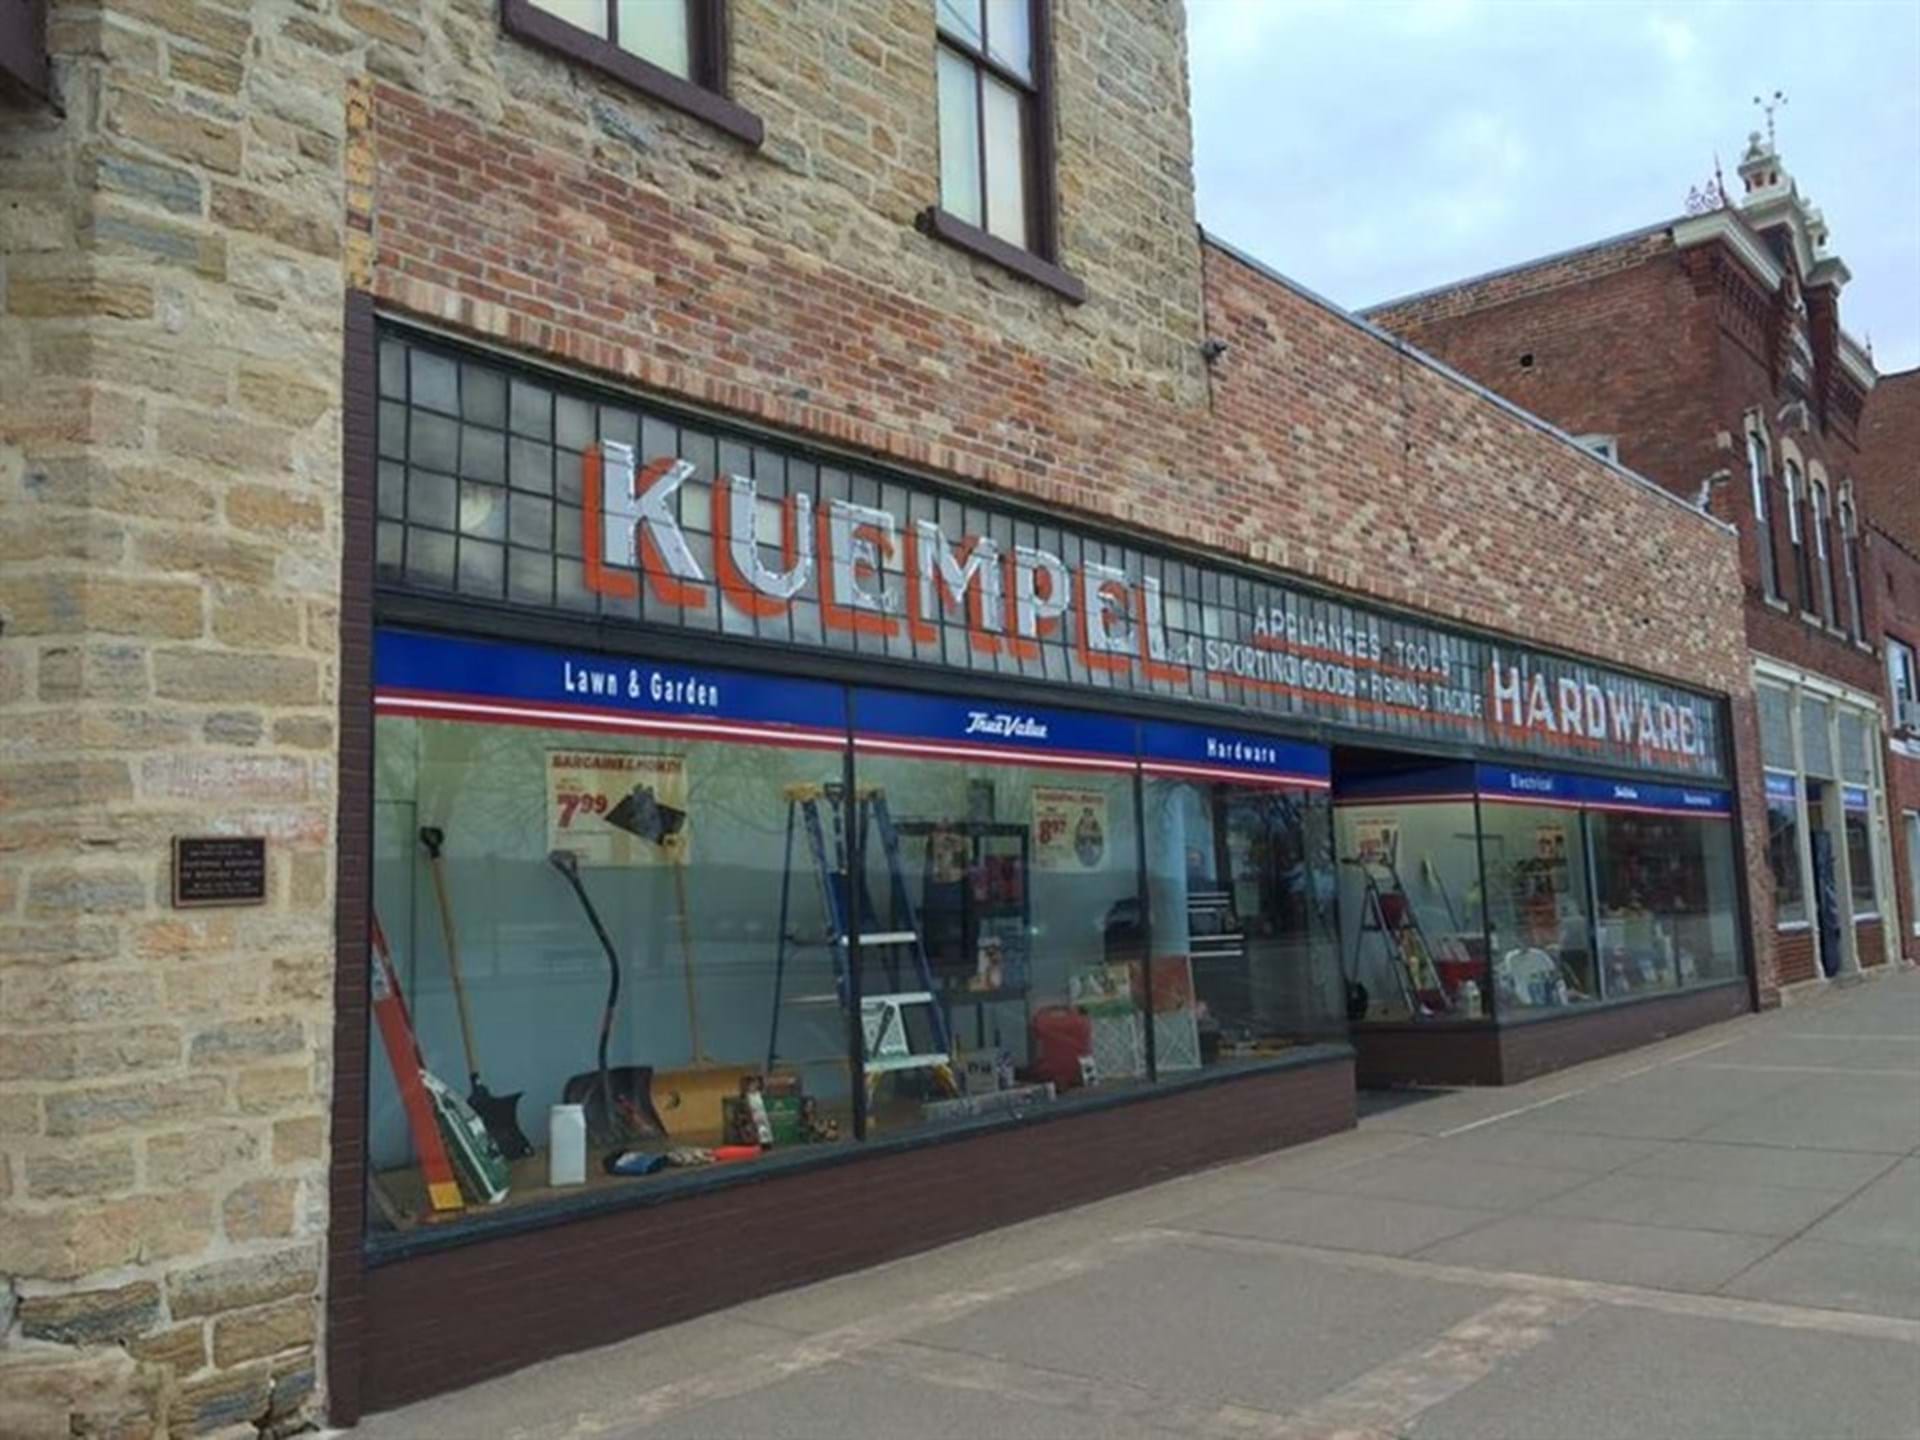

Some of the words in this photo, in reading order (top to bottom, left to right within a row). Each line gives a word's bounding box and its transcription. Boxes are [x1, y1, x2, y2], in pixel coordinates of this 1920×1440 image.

[593, 438, 1194, 678] KUEMPEL
[1205, 639, 1299, 687] SPORTING
[1301, 659, 1356, 697] GOODS
[1253, 604, 1381, 662] APPLIANCES
[1394, 640, 1450, 677] TOOLS
[565, 661, 618, 696] Lawn
[628, 669, 640, 698] &
[650, 672, 718, 707] Garden
[1491, 656, 1705, 755] HARDWARE
[1206, 737, 1277, 764] Hardware
